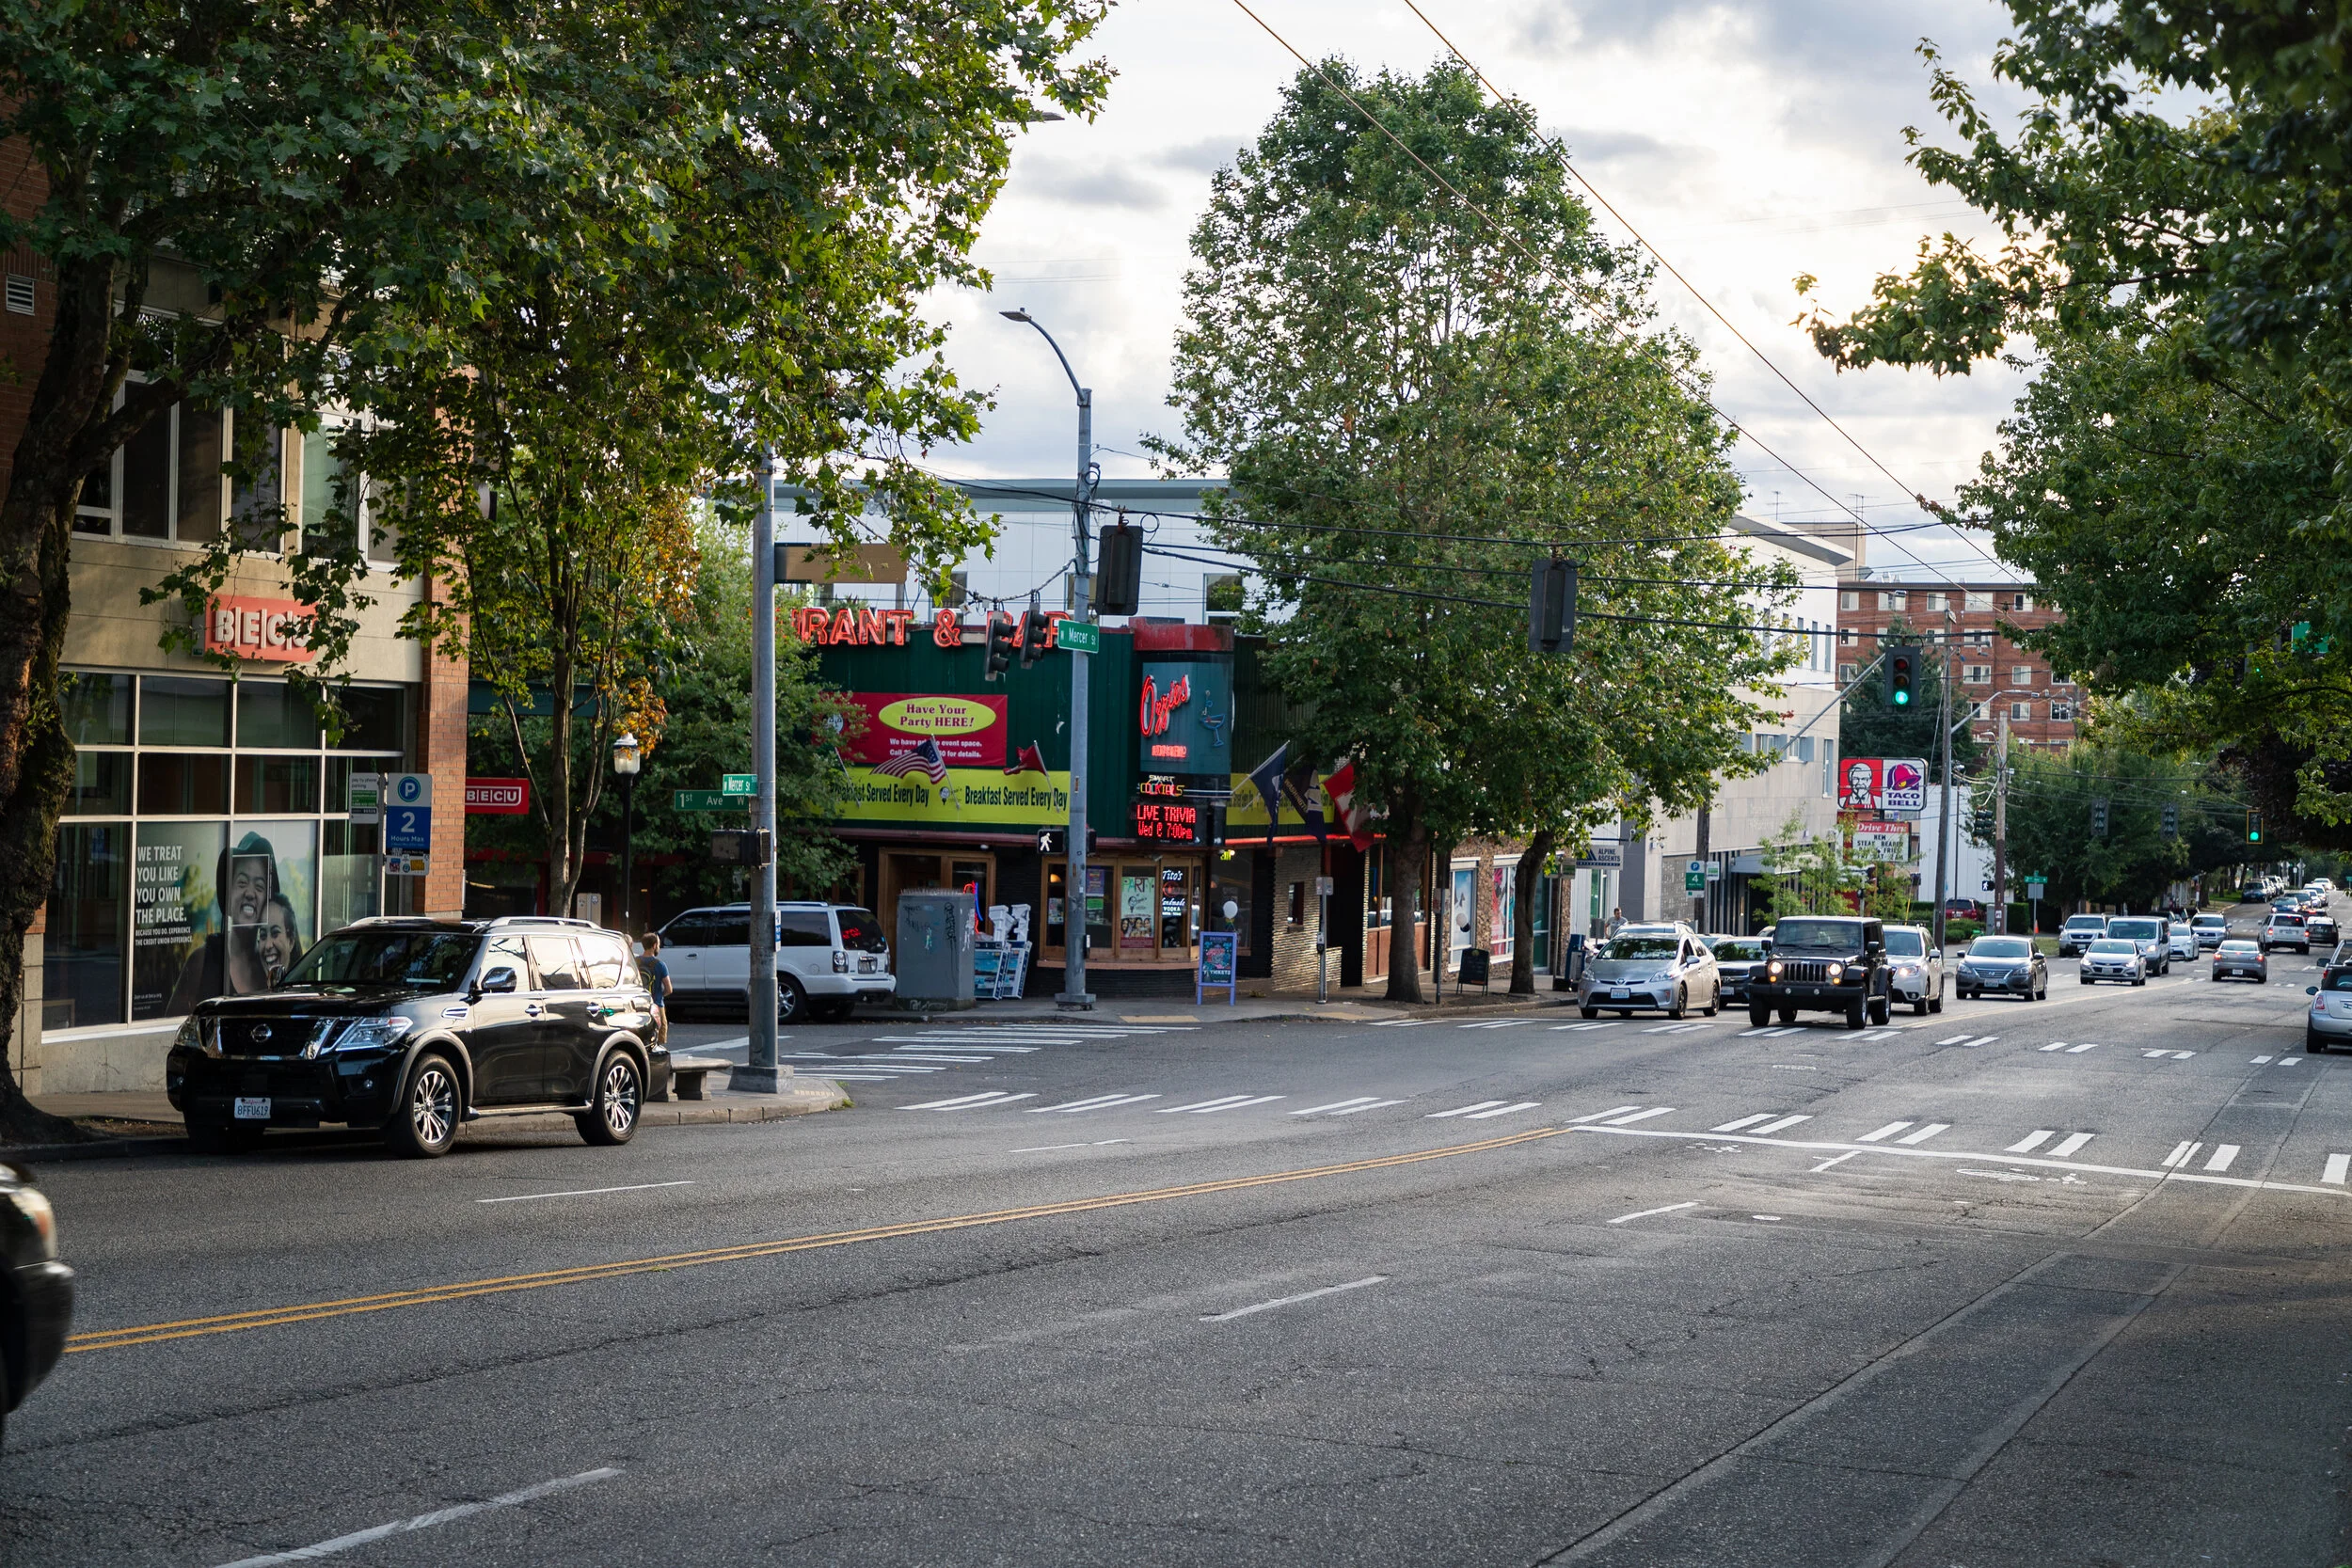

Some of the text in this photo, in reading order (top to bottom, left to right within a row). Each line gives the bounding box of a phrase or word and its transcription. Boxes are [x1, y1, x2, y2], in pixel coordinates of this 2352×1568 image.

[932, 609, 961, 647] &
[1068, 627, 1089, 644] Mercer
[906, 704, 967, 714] Have Your
[900, 716, 975, 729] Party HERE!
[405, 783, 416, 797] P
[728, 777, 744, 792] Mercer
[466, 790, 517, 802] BECU
[679, 793, 745, 808] 1st Ave W
[866, 783, 892, 802] Served
[894, 784, 914, 807] Every
[915, 784, 930, 808] Day
[965, 785, 1002, 805] Breakfast
[1003, 785, 1029, 806] Served
[1031, 786, 1052, 811] Every
[1053, 787, 1068, 811] Day
[1136, 804, 1197, 823] LIVE TRIVIA
[401, 812, 416, 832] 2
[1138, 821, 1153, 836] Wed
[1856, 823, 1882, 832] Drive
[137, 845, 183, 863] WE TREAT
[1597, 854, 1621, 863] ASCENTS
[136, 865, 179, 882] YOU LIKE
[1162, 869, 1184, 880] Tito's
[1692, 874, 1699, 883] 4
[1120, 877, 1155, 893] PARTY
[136, 886, 181, 903] YOU OWN
[135, 907, 187, 925] THE PLACE.
[152, 927, 161, 936] YOU
